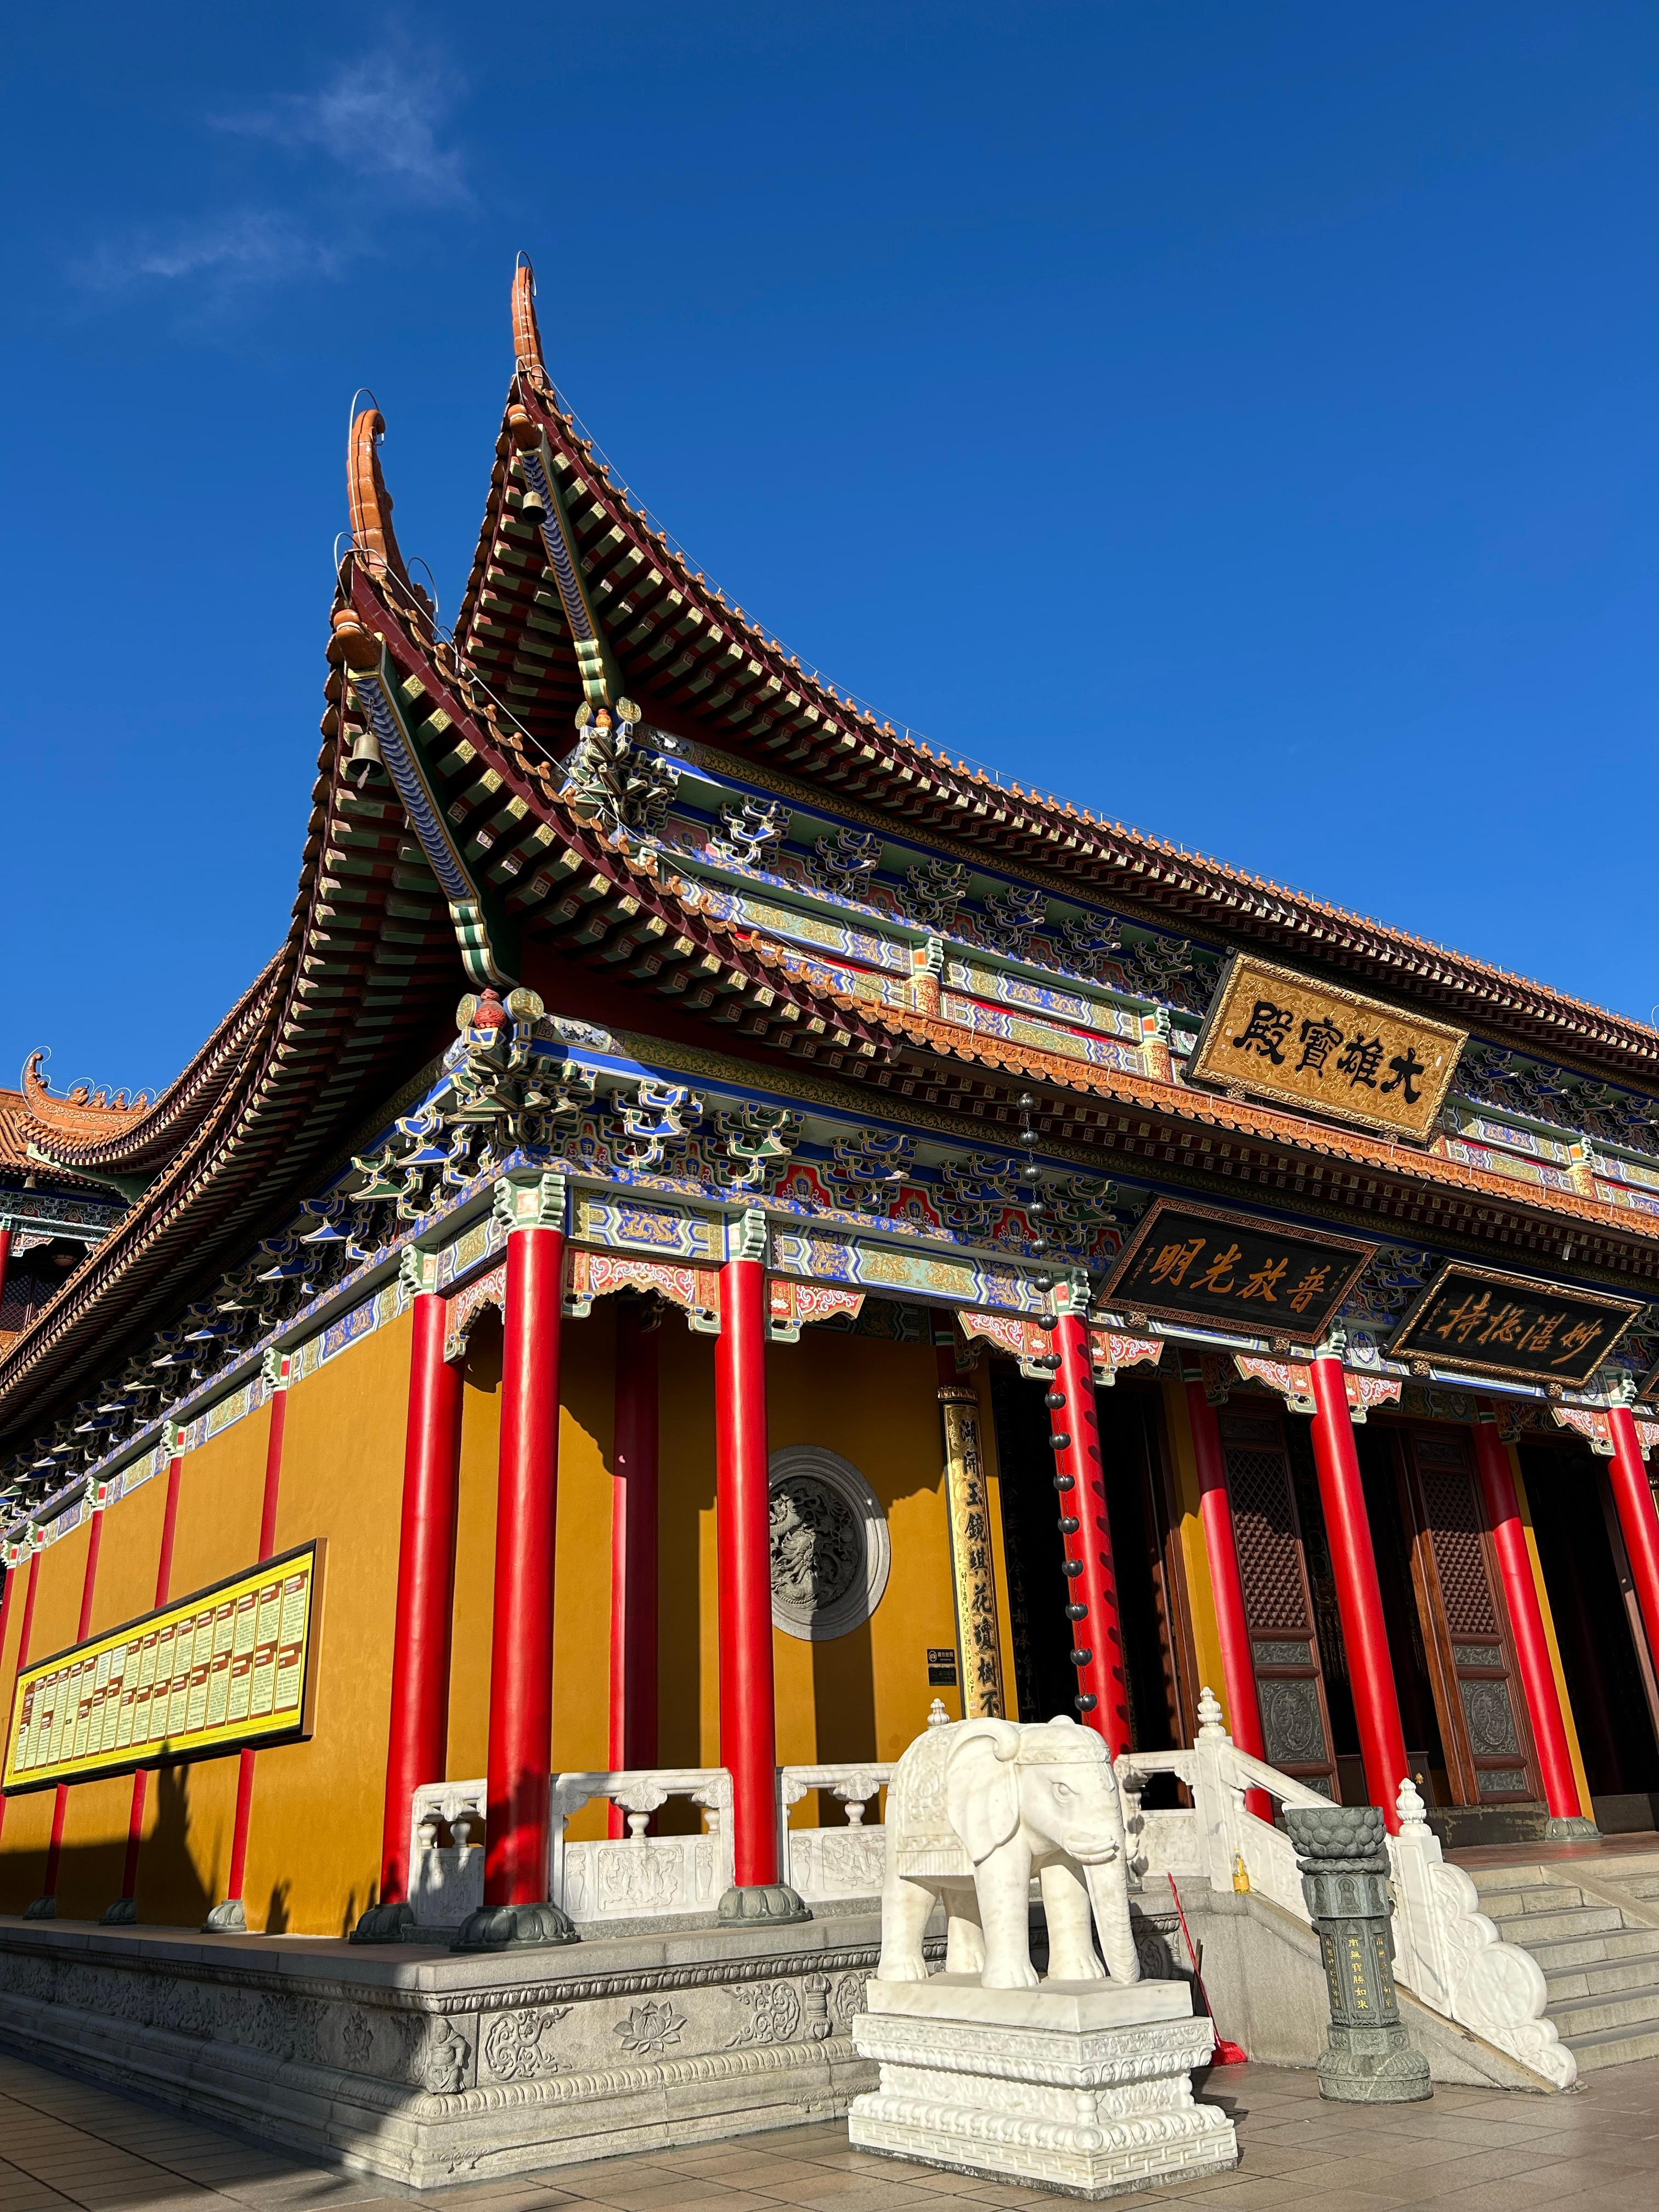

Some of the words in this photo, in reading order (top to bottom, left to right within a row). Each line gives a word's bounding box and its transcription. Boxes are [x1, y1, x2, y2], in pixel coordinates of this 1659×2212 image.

[1149, 1238, 1331, 1313] 普放光明
[1348, 1939, 1369, 2009] 南無寶勝如來
